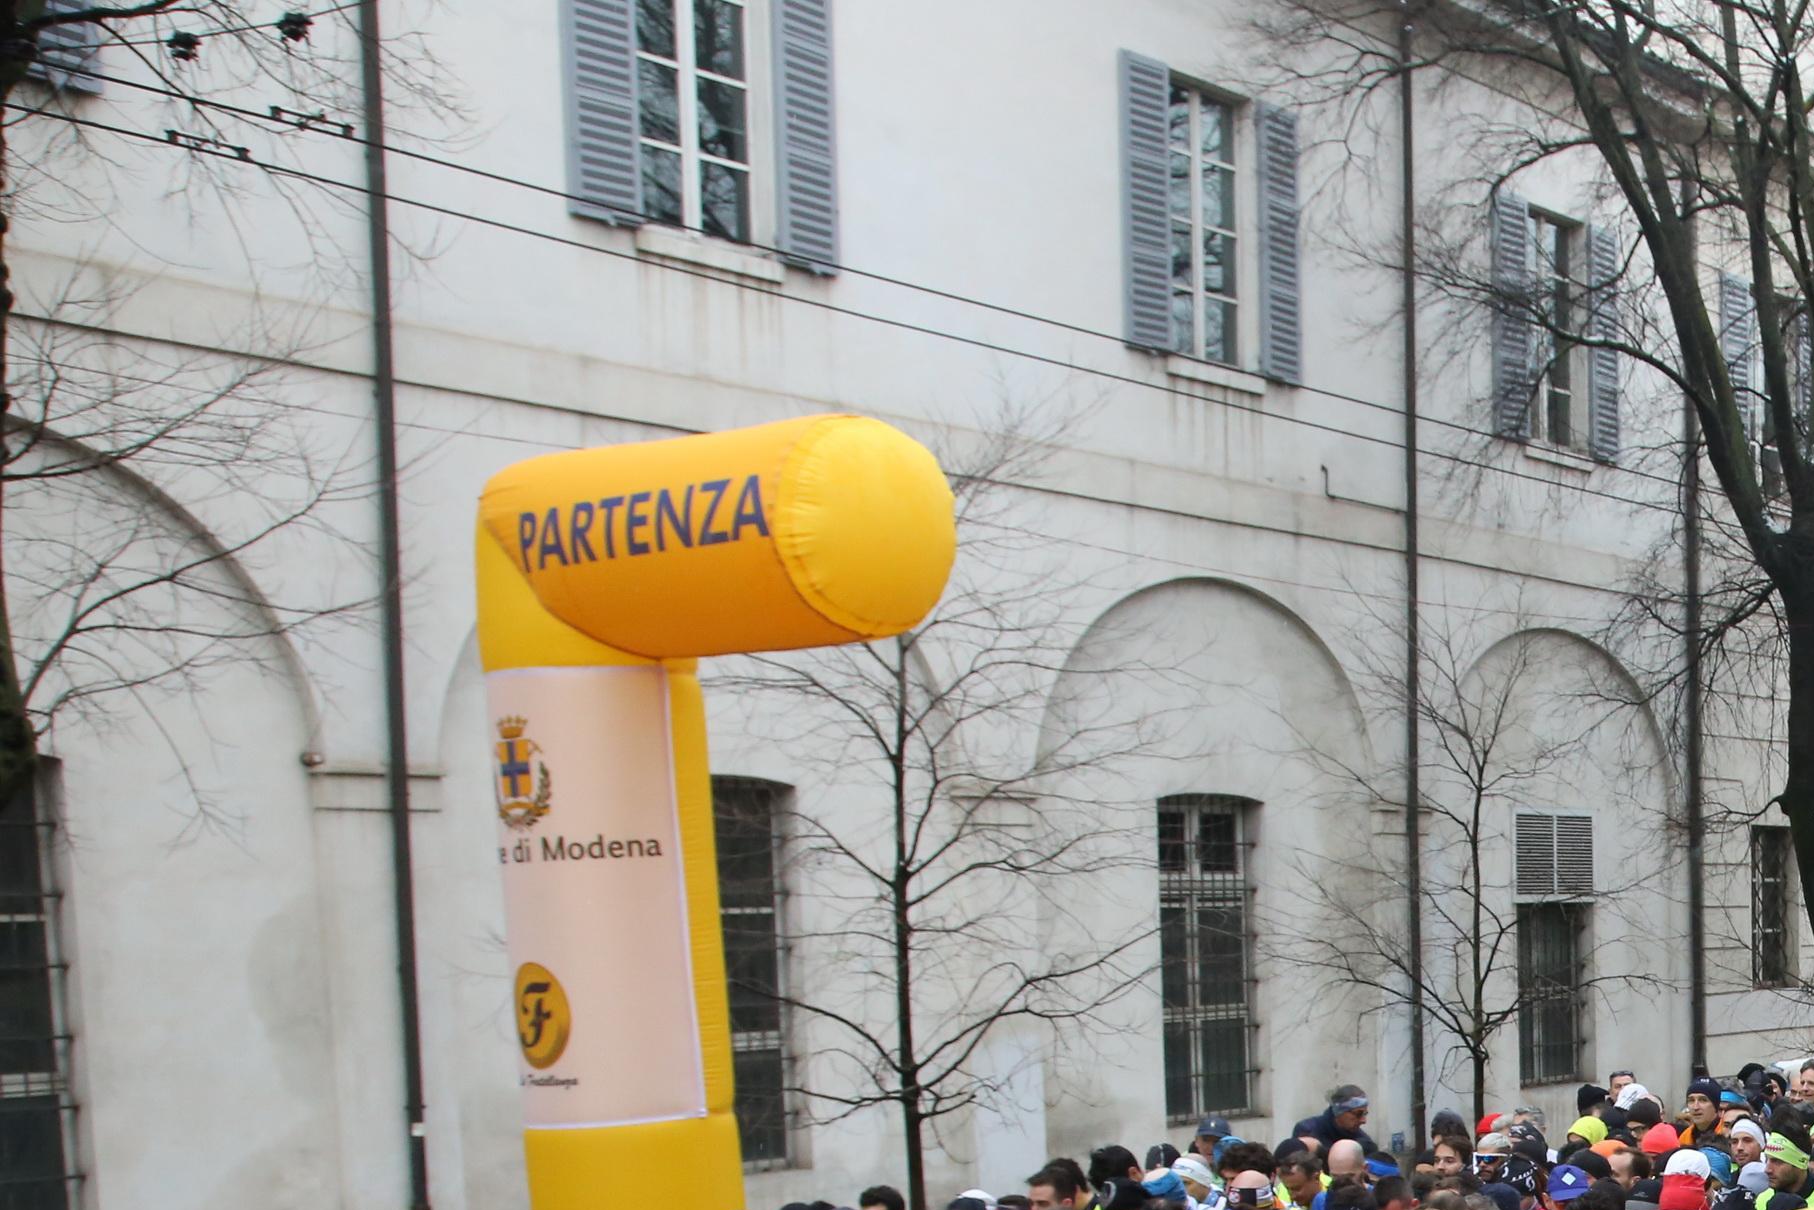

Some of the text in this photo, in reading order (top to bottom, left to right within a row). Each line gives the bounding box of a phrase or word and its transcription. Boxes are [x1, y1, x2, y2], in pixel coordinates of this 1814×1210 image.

[519, 475, 770, 572] PARTENZA
[499, 834, 662, 863] e di Modena
